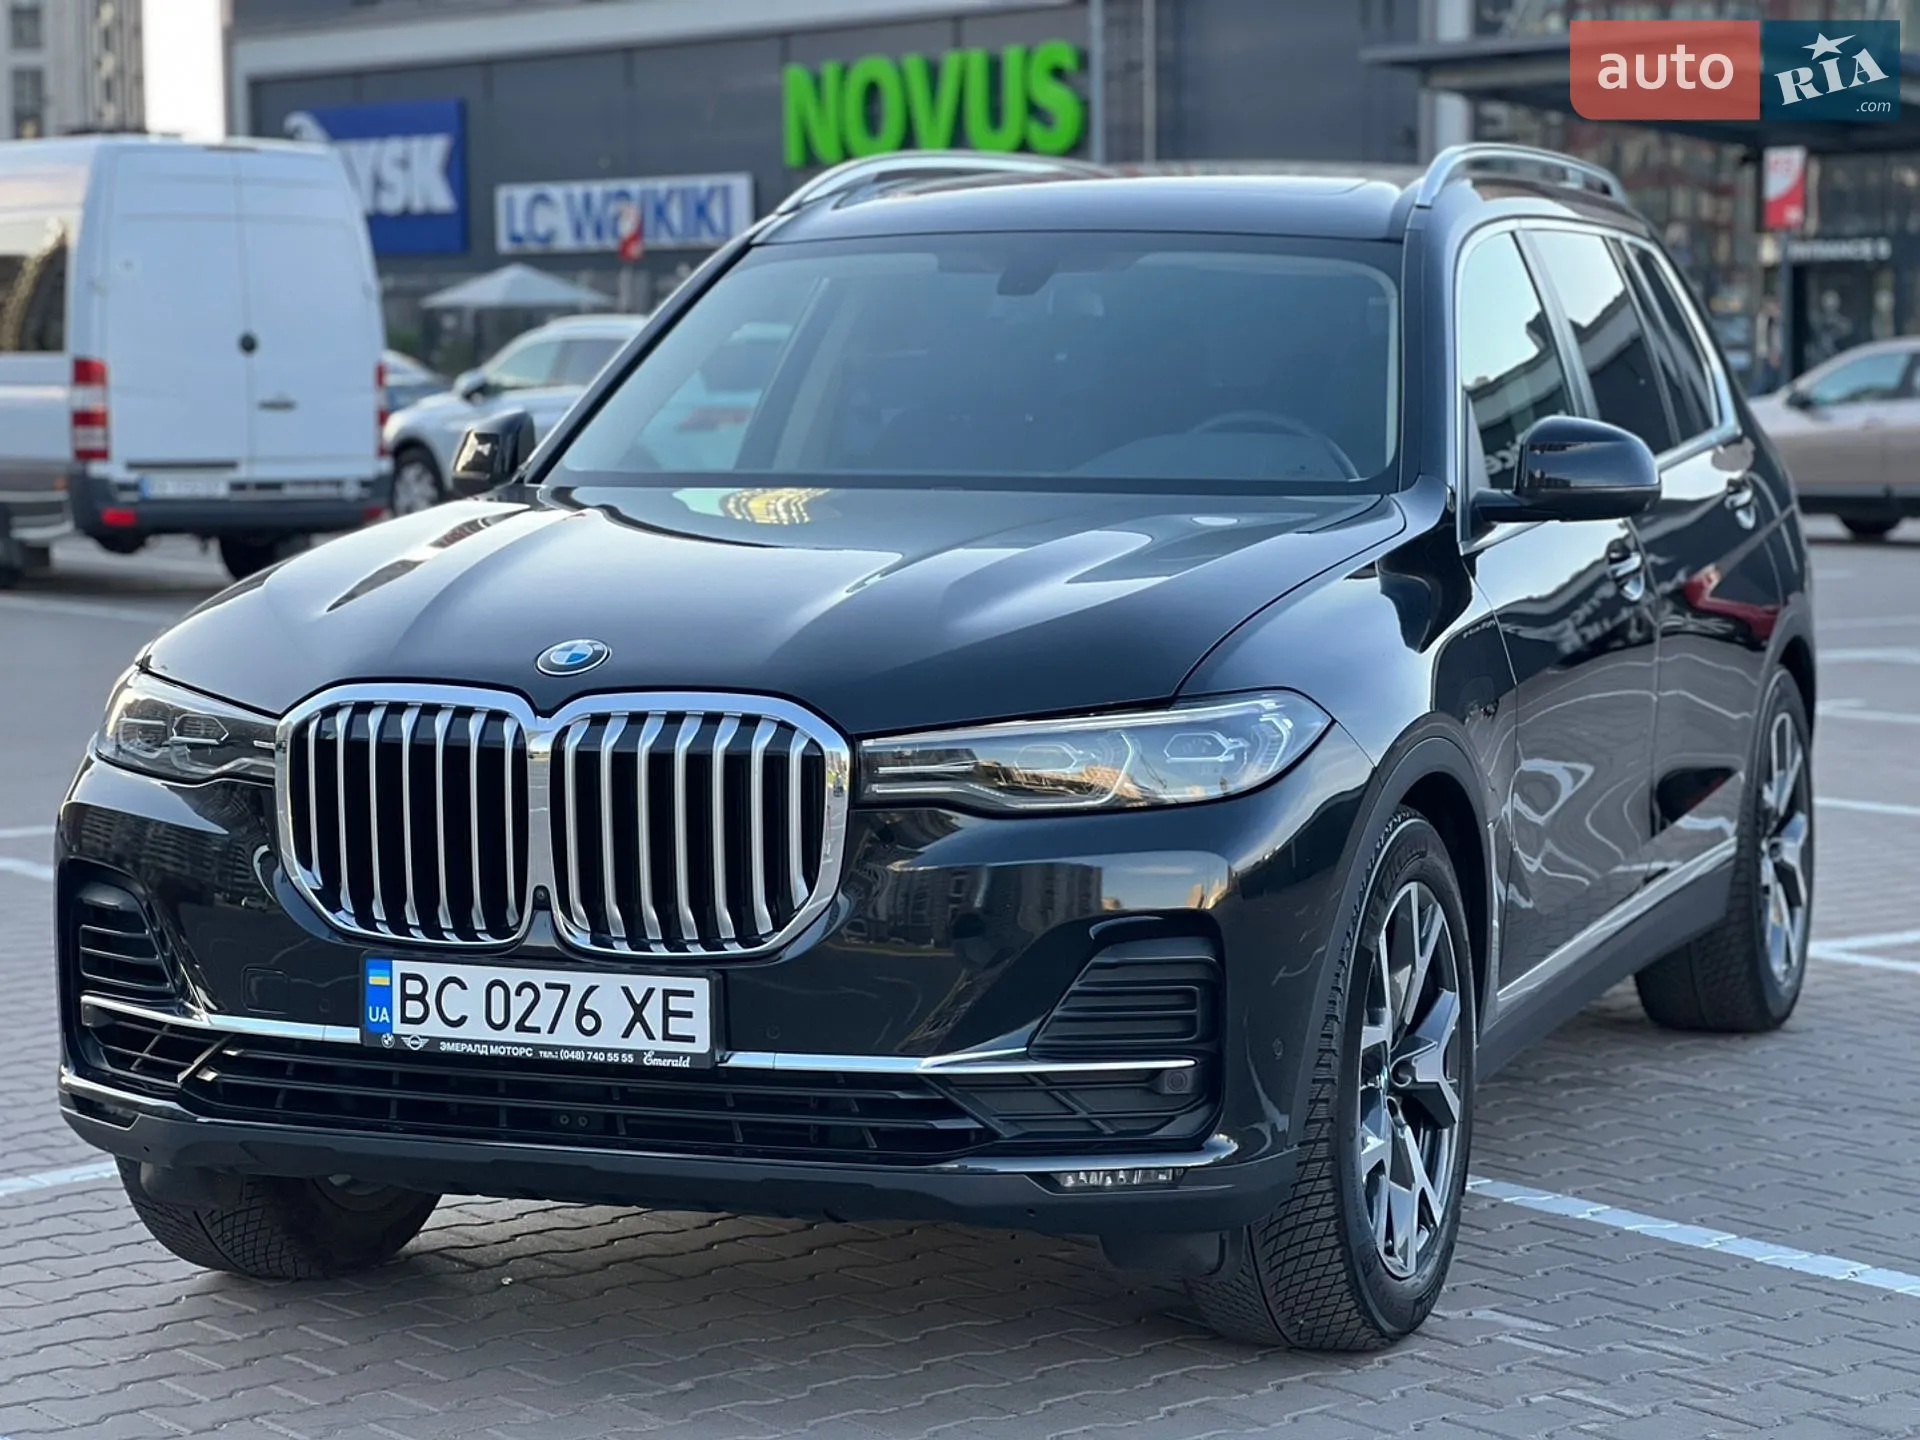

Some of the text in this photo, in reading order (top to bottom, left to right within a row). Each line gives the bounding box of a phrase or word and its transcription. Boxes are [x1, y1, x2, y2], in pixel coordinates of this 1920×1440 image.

[783, 38, 1083, 168] NOVUS
[338, 132, 458, 216] YSK
[505, 191, 556, 244] LC
[369, 1006, 390, 1023] UA
[400, 972, 697, 1043] BC 0276 XE
[440, 1041, 488, 1056] ЭМЕРАЛД
[490, 1045, 533, 1057] МОТОРС
[560, 1049, 585, 1061] (048)
[587, 1051, 605, 1062] 740
[607, 1053, 619, 1063] 55
[621, 1053, 634, 1063] 55
[643, 1050, 691, 1068] Emerald
